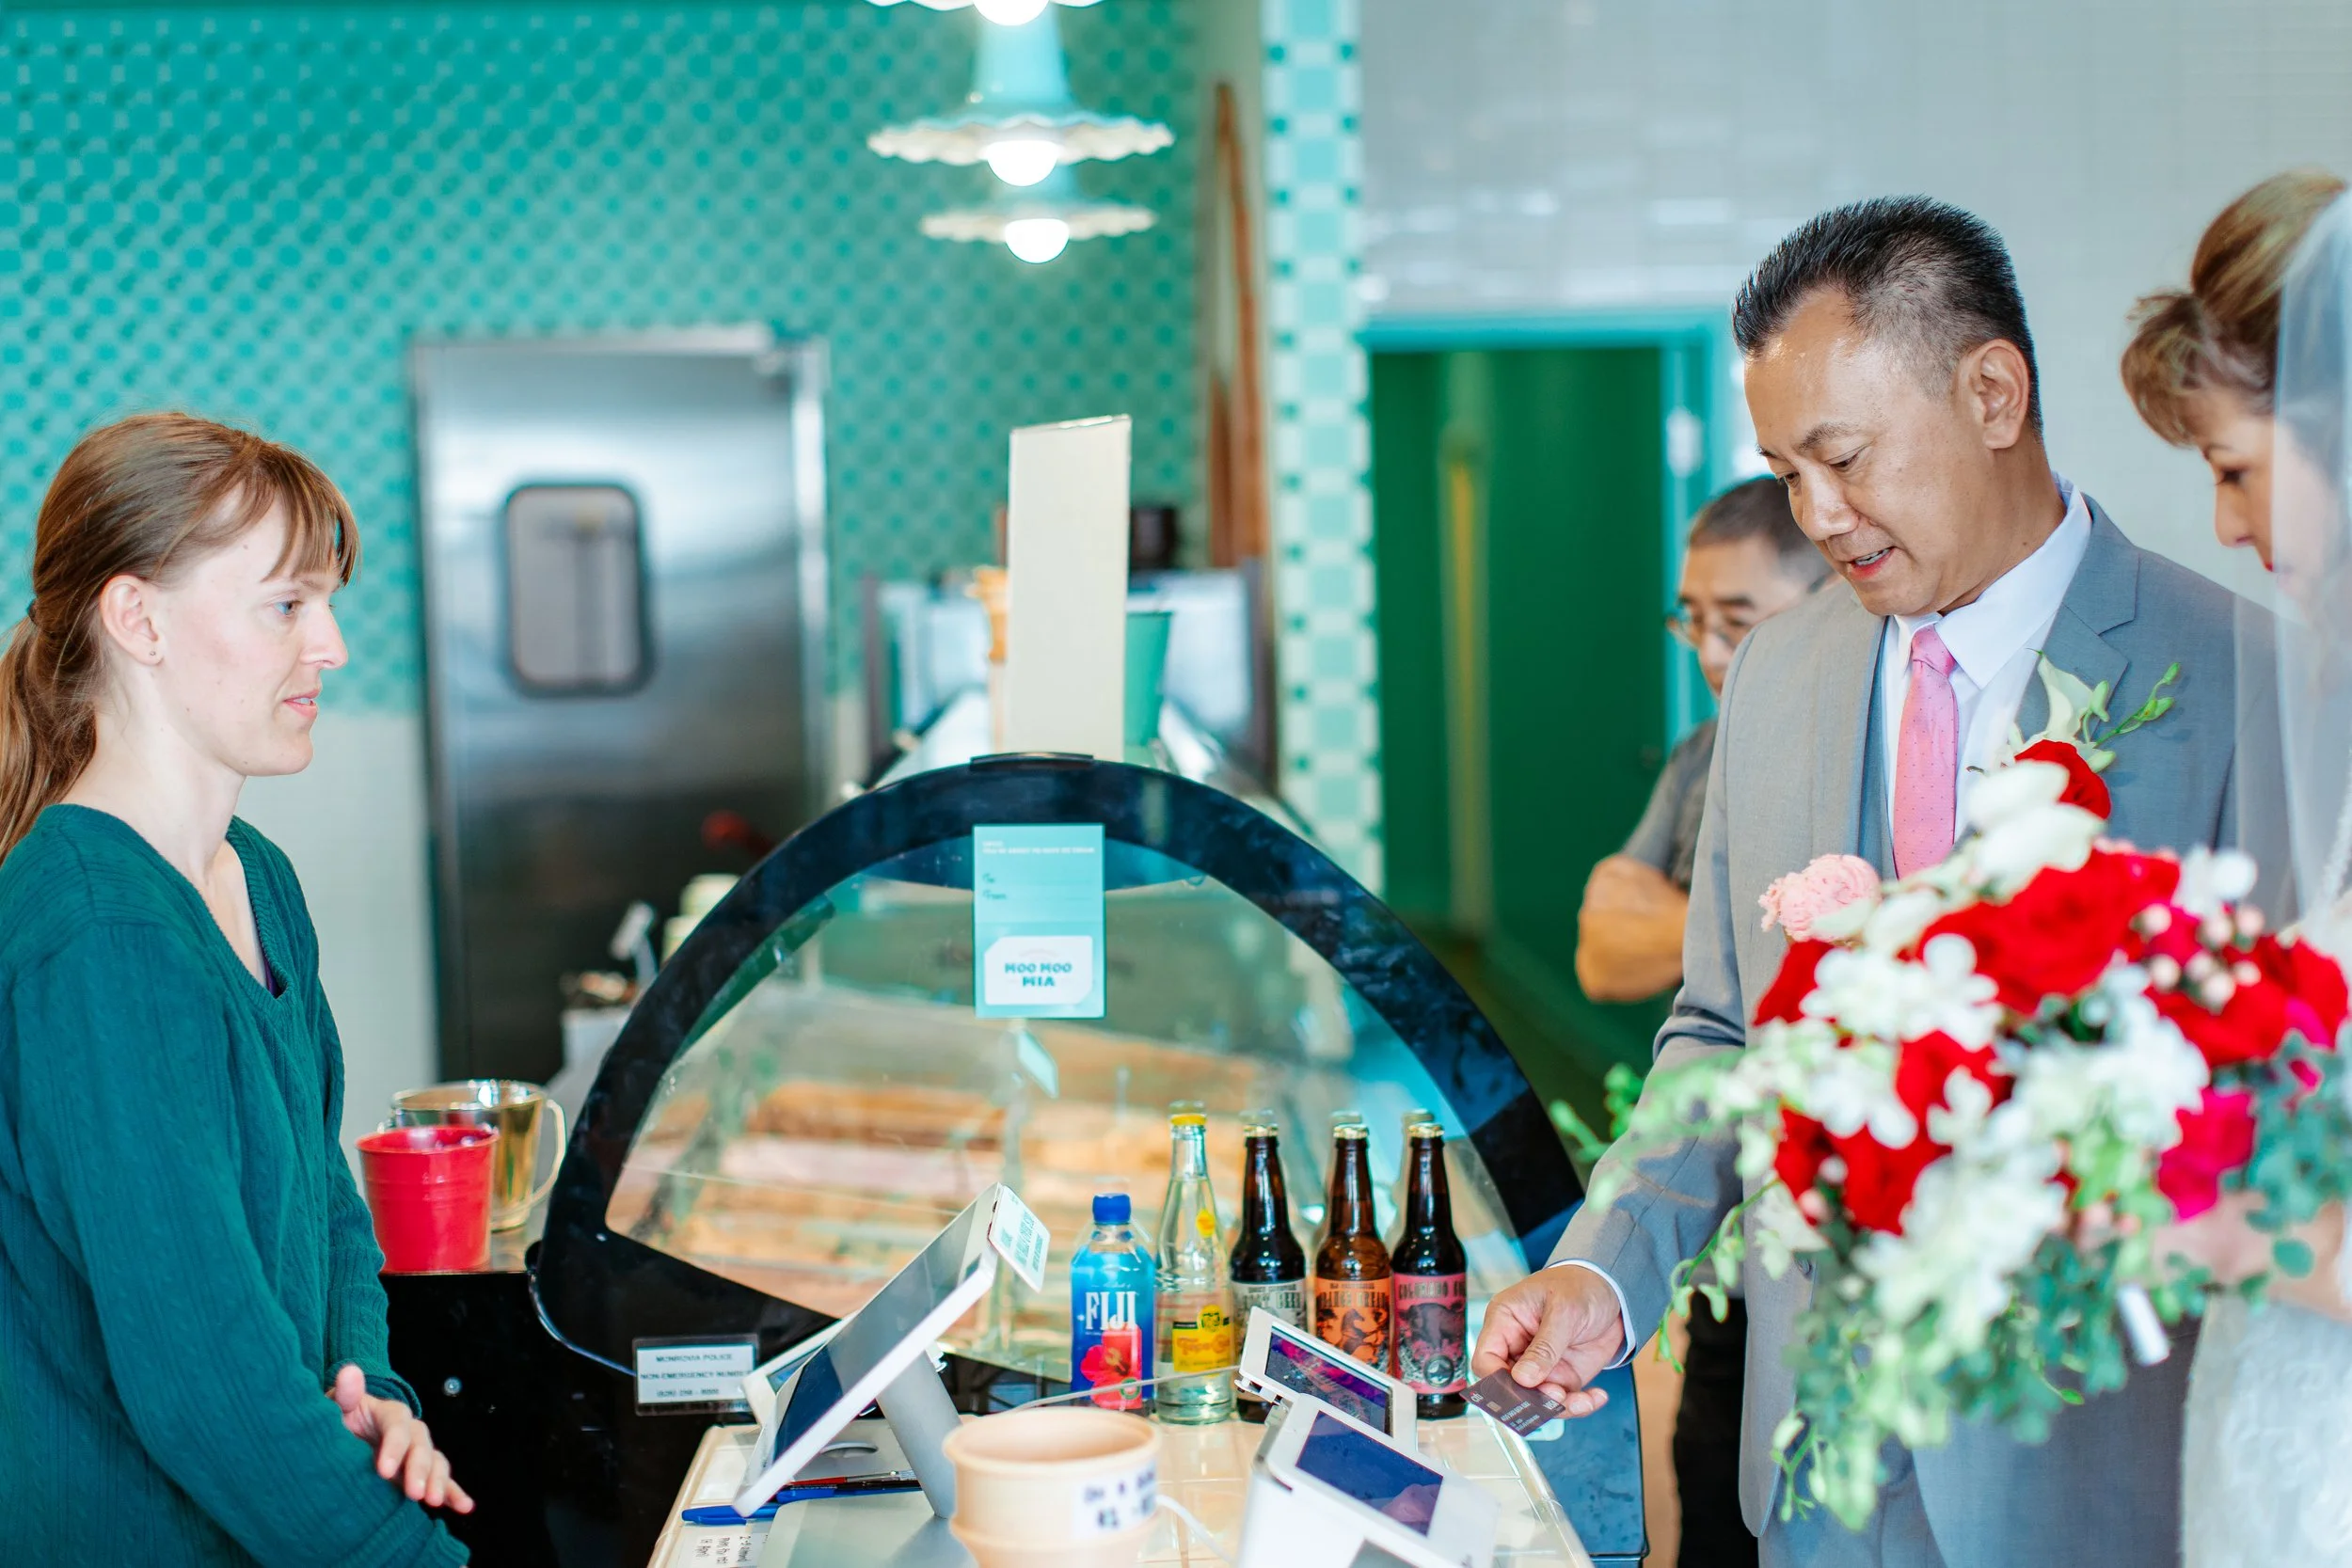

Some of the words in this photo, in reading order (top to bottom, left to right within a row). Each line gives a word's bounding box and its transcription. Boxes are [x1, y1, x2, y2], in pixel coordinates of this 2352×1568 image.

[1005, 962, 1036, 974] MOO
[1041, 962, 1073, 974] MOO
[1023, 976, 1055, 987] MIA
[1085, 1291, 1137, 1331] FIJI
